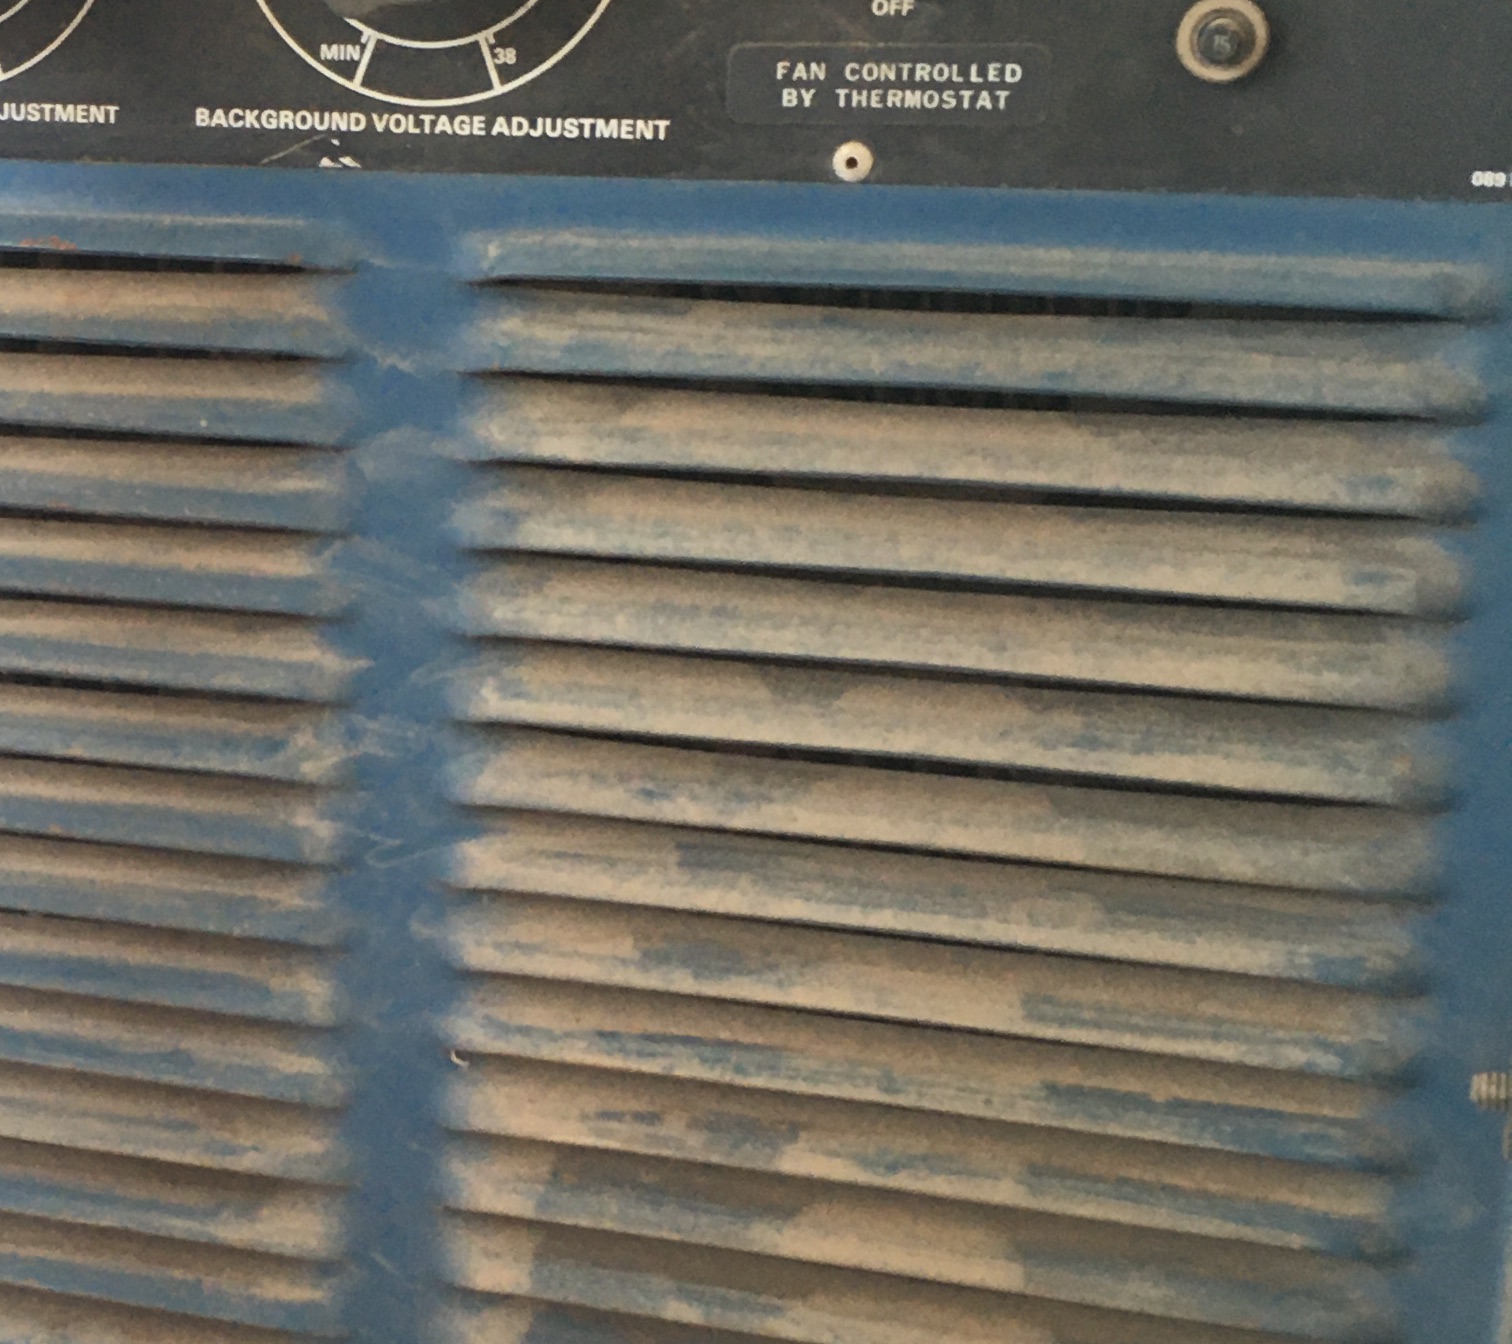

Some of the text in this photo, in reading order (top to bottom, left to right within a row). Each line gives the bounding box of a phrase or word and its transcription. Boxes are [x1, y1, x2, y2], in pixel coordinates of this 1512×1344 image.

[320, 42, 362, 62] MIN
[776, 60, 1023, 84] FAN CONTROLLED
[781, 87, 1010, 110] BY THERMOSTAT
[195, 107, 671, 141] BACKGROUND VOLTAGE ADJUSTMENT
